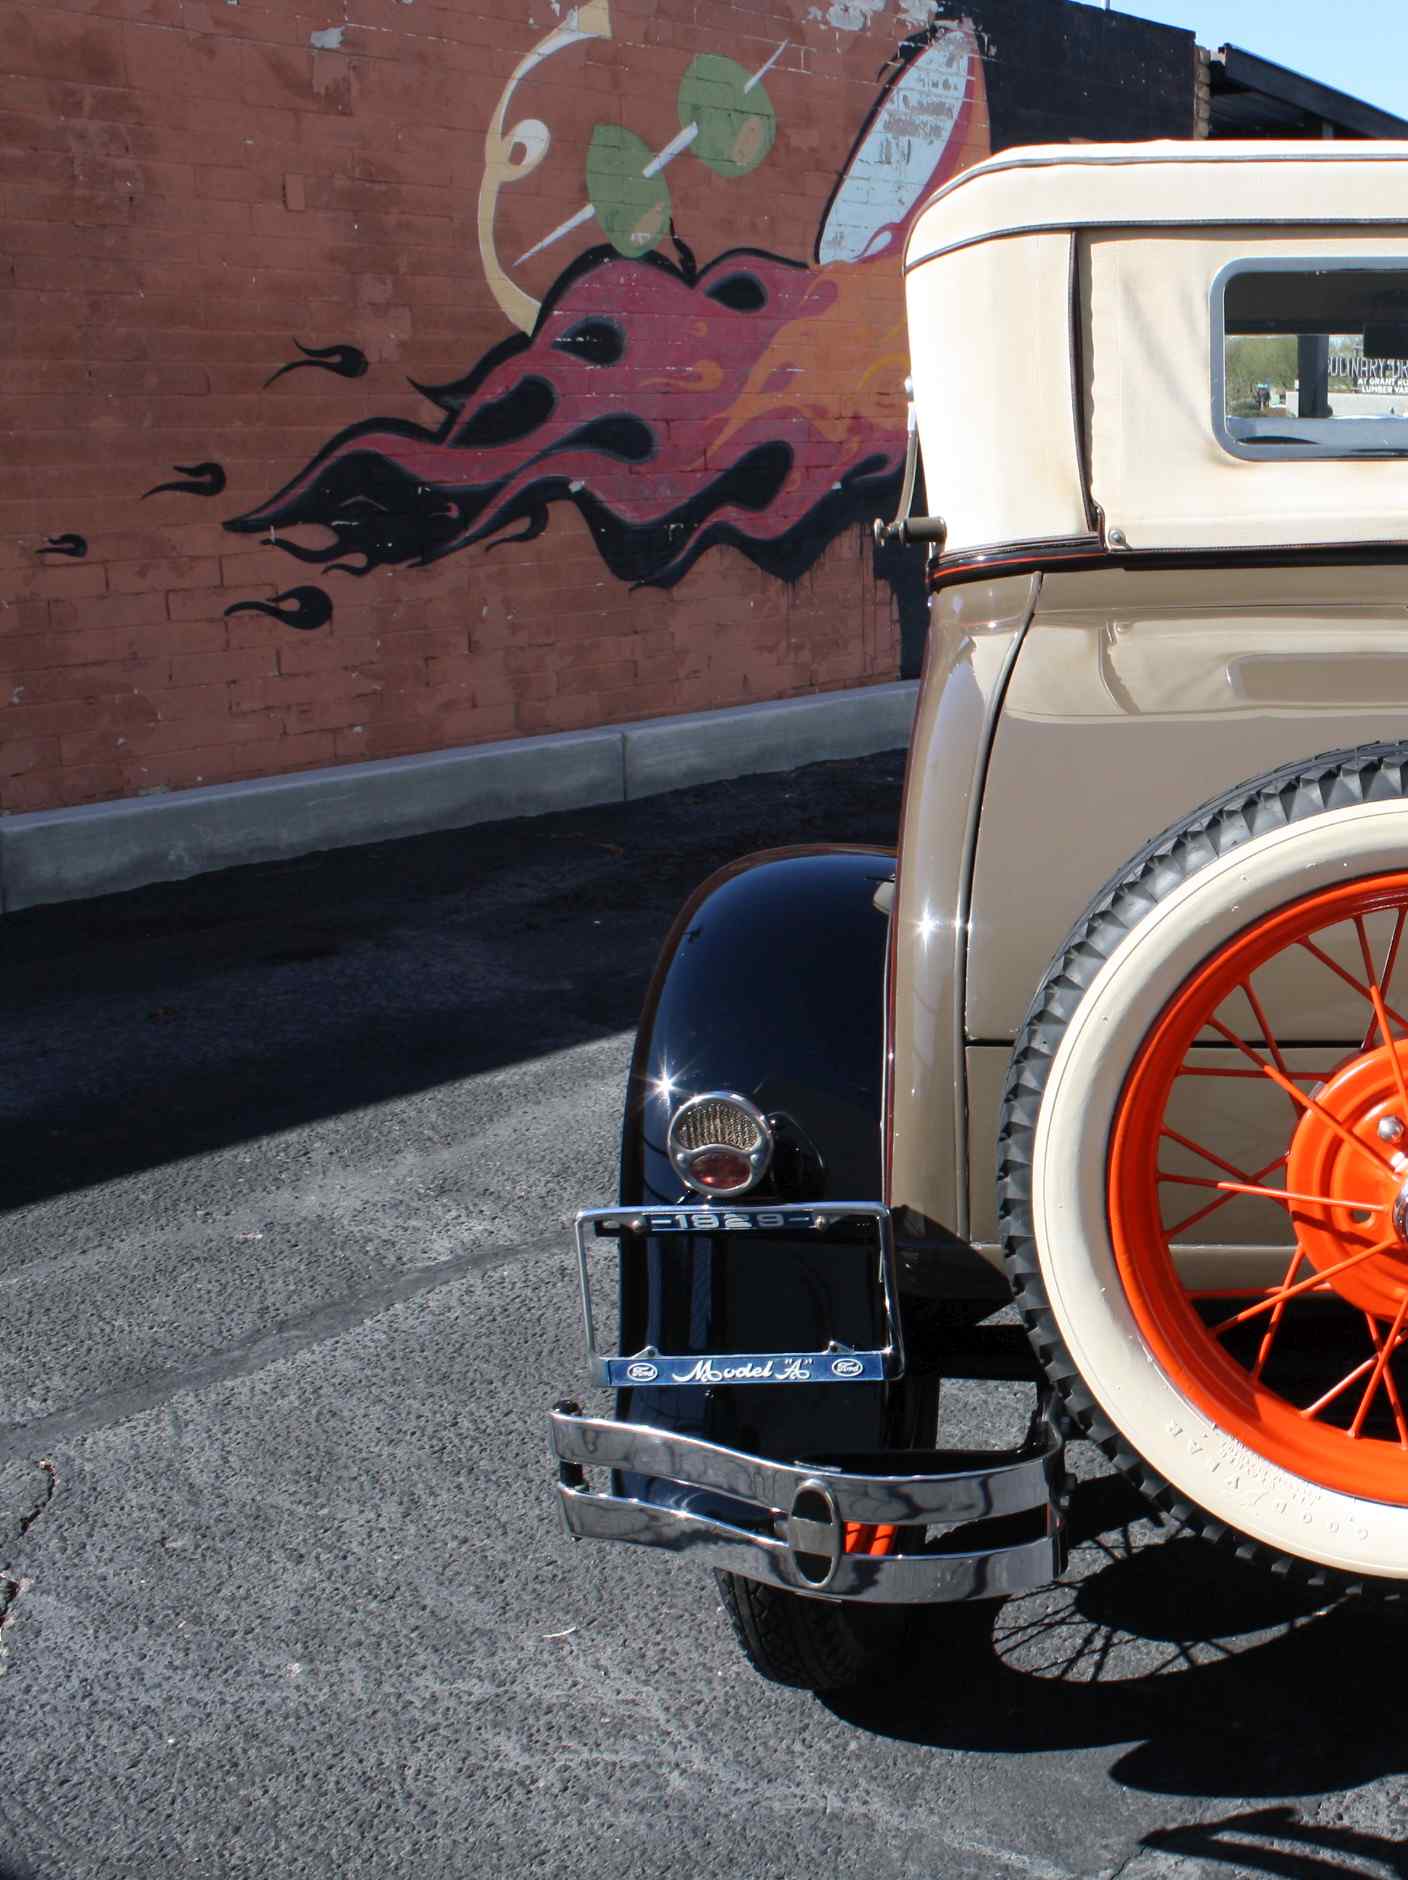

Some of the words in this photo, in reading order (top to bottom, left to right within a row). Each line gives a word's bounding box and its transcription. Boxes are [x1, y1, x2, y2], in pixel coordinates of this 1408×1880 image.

[1369, 377, 1395, 386] GRANT
[1361, 385, 1392, 394] LUMBER
[672, 1359, 773, 1382] Model
